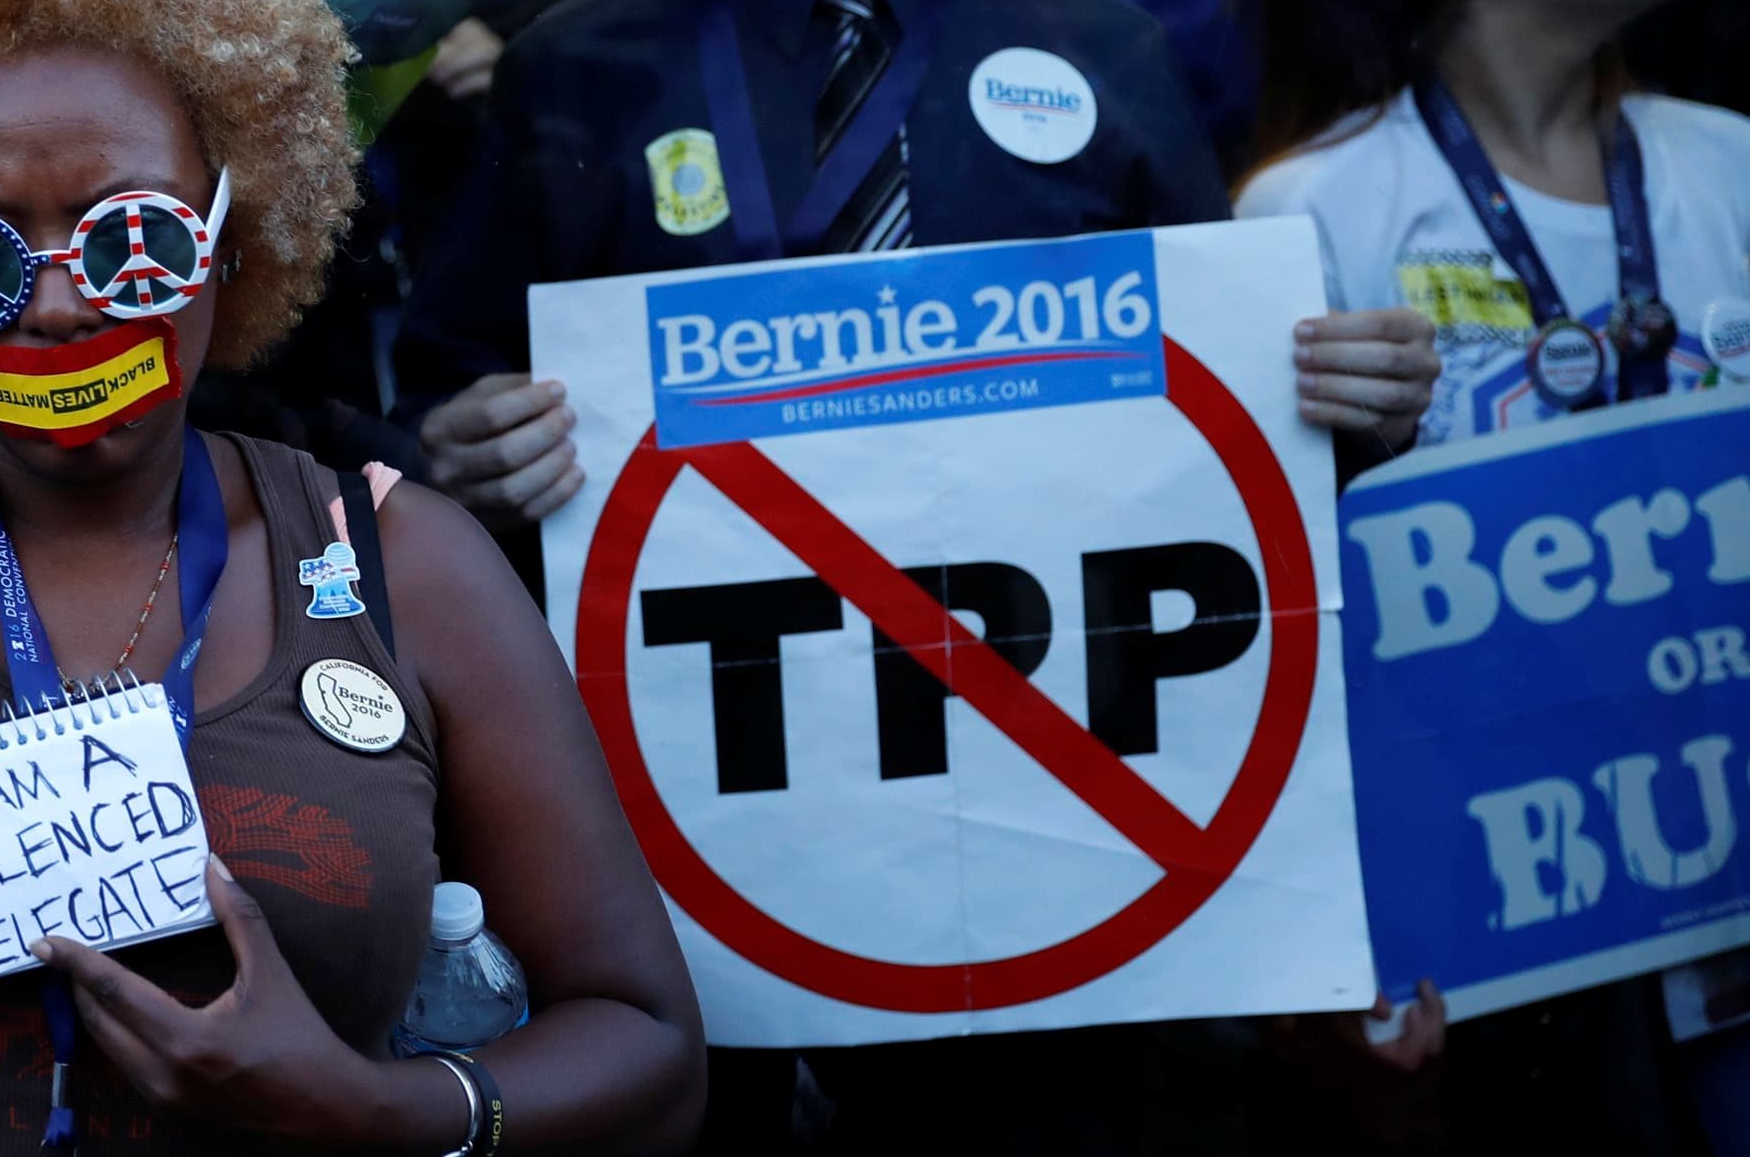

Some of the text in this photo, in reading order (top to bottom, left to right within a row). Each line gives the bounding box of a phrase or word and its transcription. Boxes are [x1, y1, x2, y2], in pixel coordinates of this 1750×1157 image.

[985, 78, 1082, 111] Bernie
[657, 271, 1152, 388] Bernie 2016
[107, 355, 156, 393] BLACK
[52, 383, 106, 410] LIVES
[780, 377, 1040, 424] BERNIESANDERS.COM
[21, 610, 39, 663] NATIONAL
[319, 662, 389, 691] CALIFORNIA FOR
[639, 540, 1262, 796] TPP
[1648, 625, 1750, 695] OR
[337, 686, 393, 713] Bernie
[351, 703, 382, 719] 2016
[319, 714, 390, 746] BERNIE SANDERS
[79, 734, 138, 792] A
[1466, 735, 1750, 932] BU
